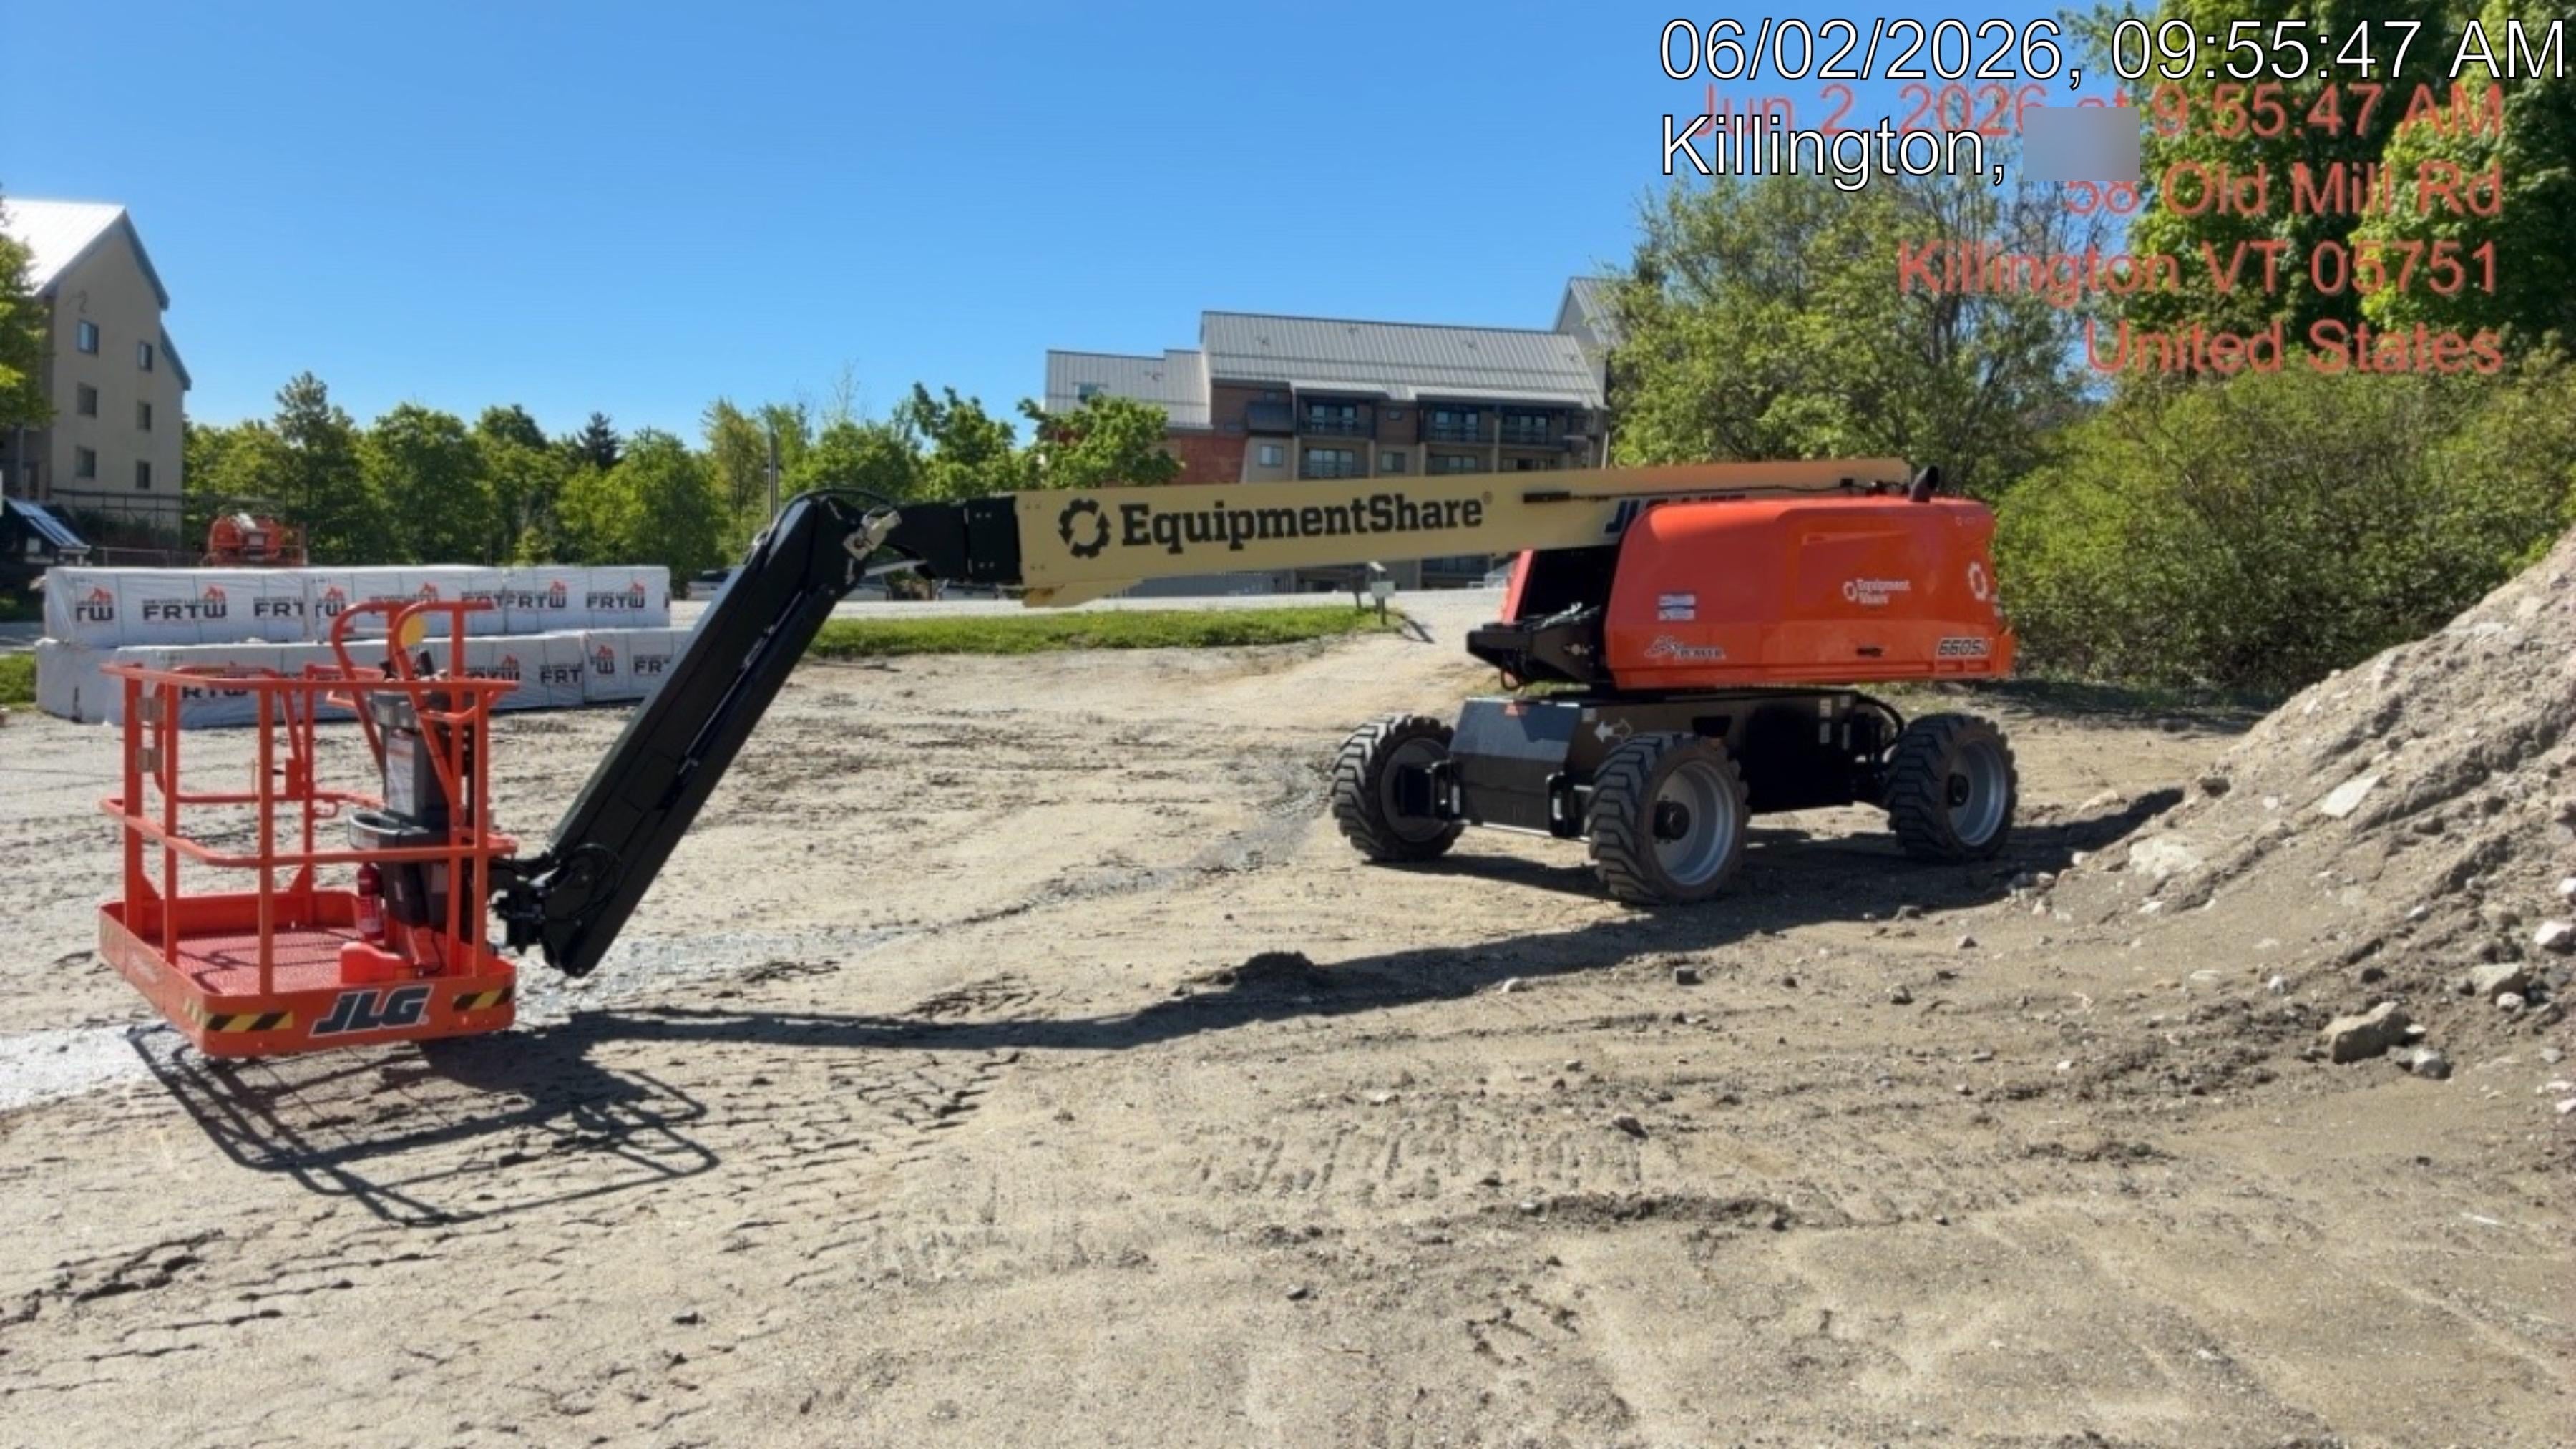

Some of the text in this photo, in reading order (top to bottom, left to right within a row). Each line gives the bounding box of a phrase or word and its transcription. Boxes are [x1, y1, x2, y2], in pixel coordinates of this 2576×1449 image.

[1119, 492, 1483, 555] EquipmentShare
[254, 601, 304, 618] FRT
[586, 594, 645, 609] FRTW
[143, 601, 227, 621] FRTW
[540, 668, 583, 684] FRT
[310, 984, 434, 1038] JLG
